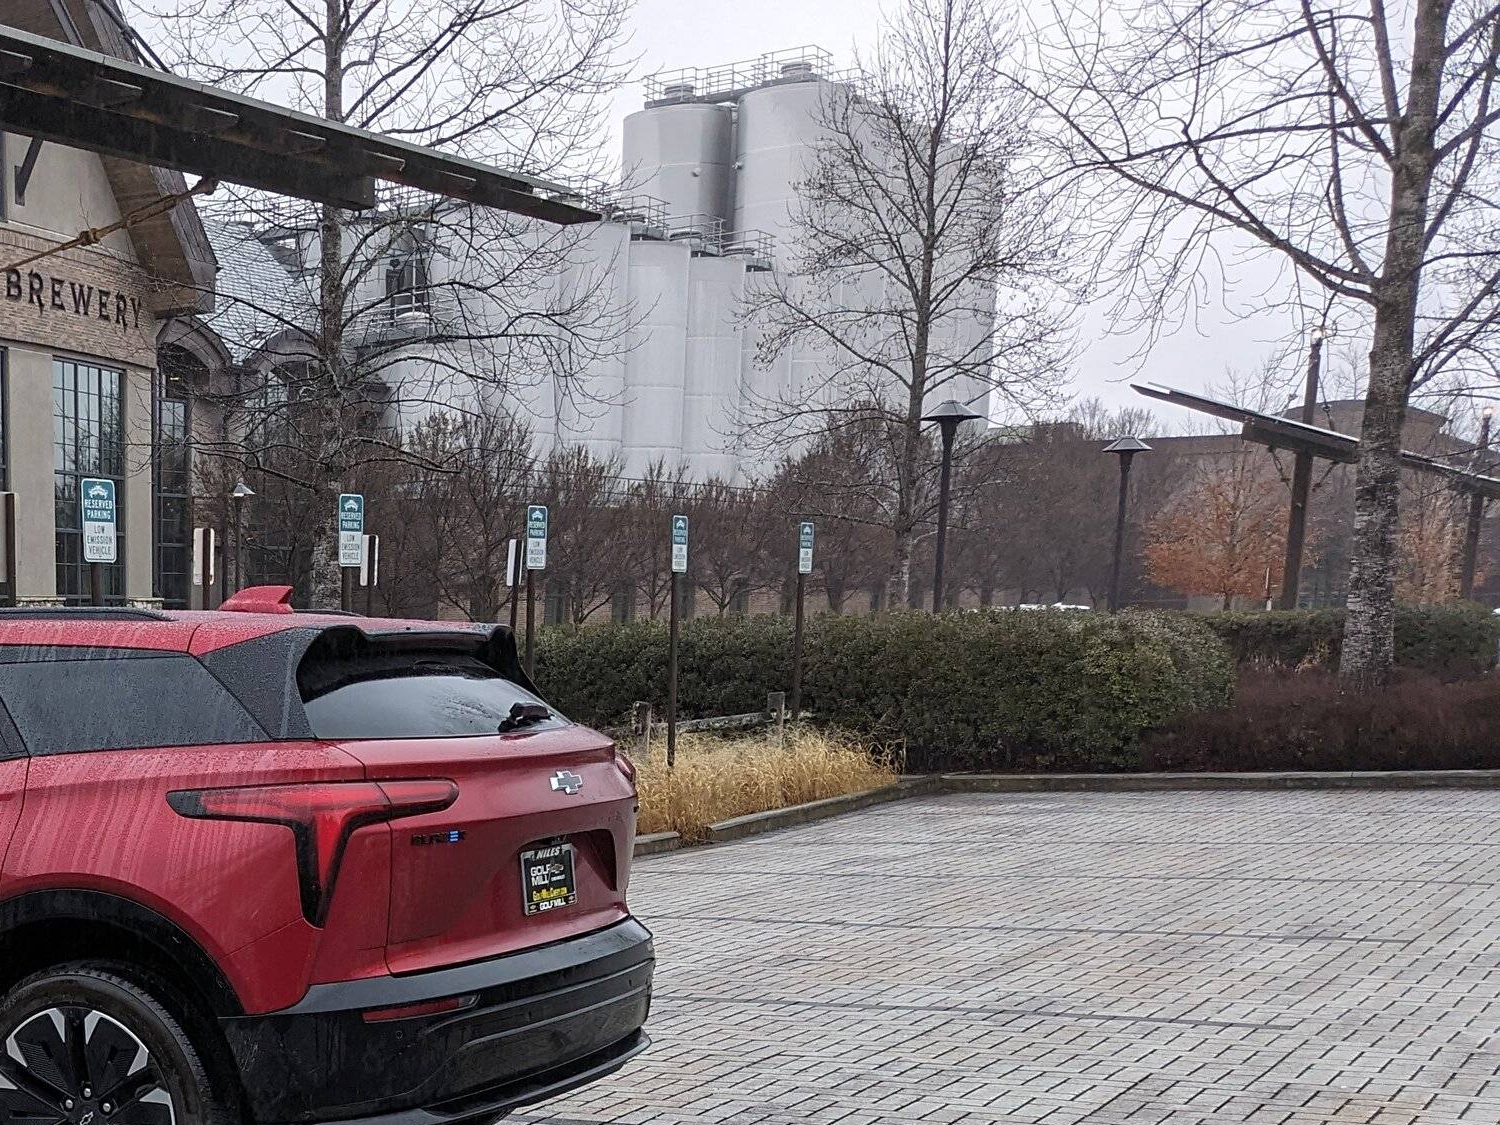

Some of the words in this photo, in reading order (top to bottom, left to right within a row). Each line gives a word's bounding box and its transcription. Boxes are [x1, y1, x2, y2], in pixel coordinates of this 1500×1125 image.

[5, 267, 142, 332] BREWERY
[84, 499, 113, 510] RESERVED
[87, 510, 111, 519] PARKING
[87, 536, 113, 545] EMISSION
[88, 546, 111, 555] VEHICLE
[536, 846, 561, 860] NILES
[531, 864, 551, 877] GOLF
[532, 874, 549, 887] MILL
[540, 901, 553, 910] GOLF
[553, 898, 567, 907] MILL
